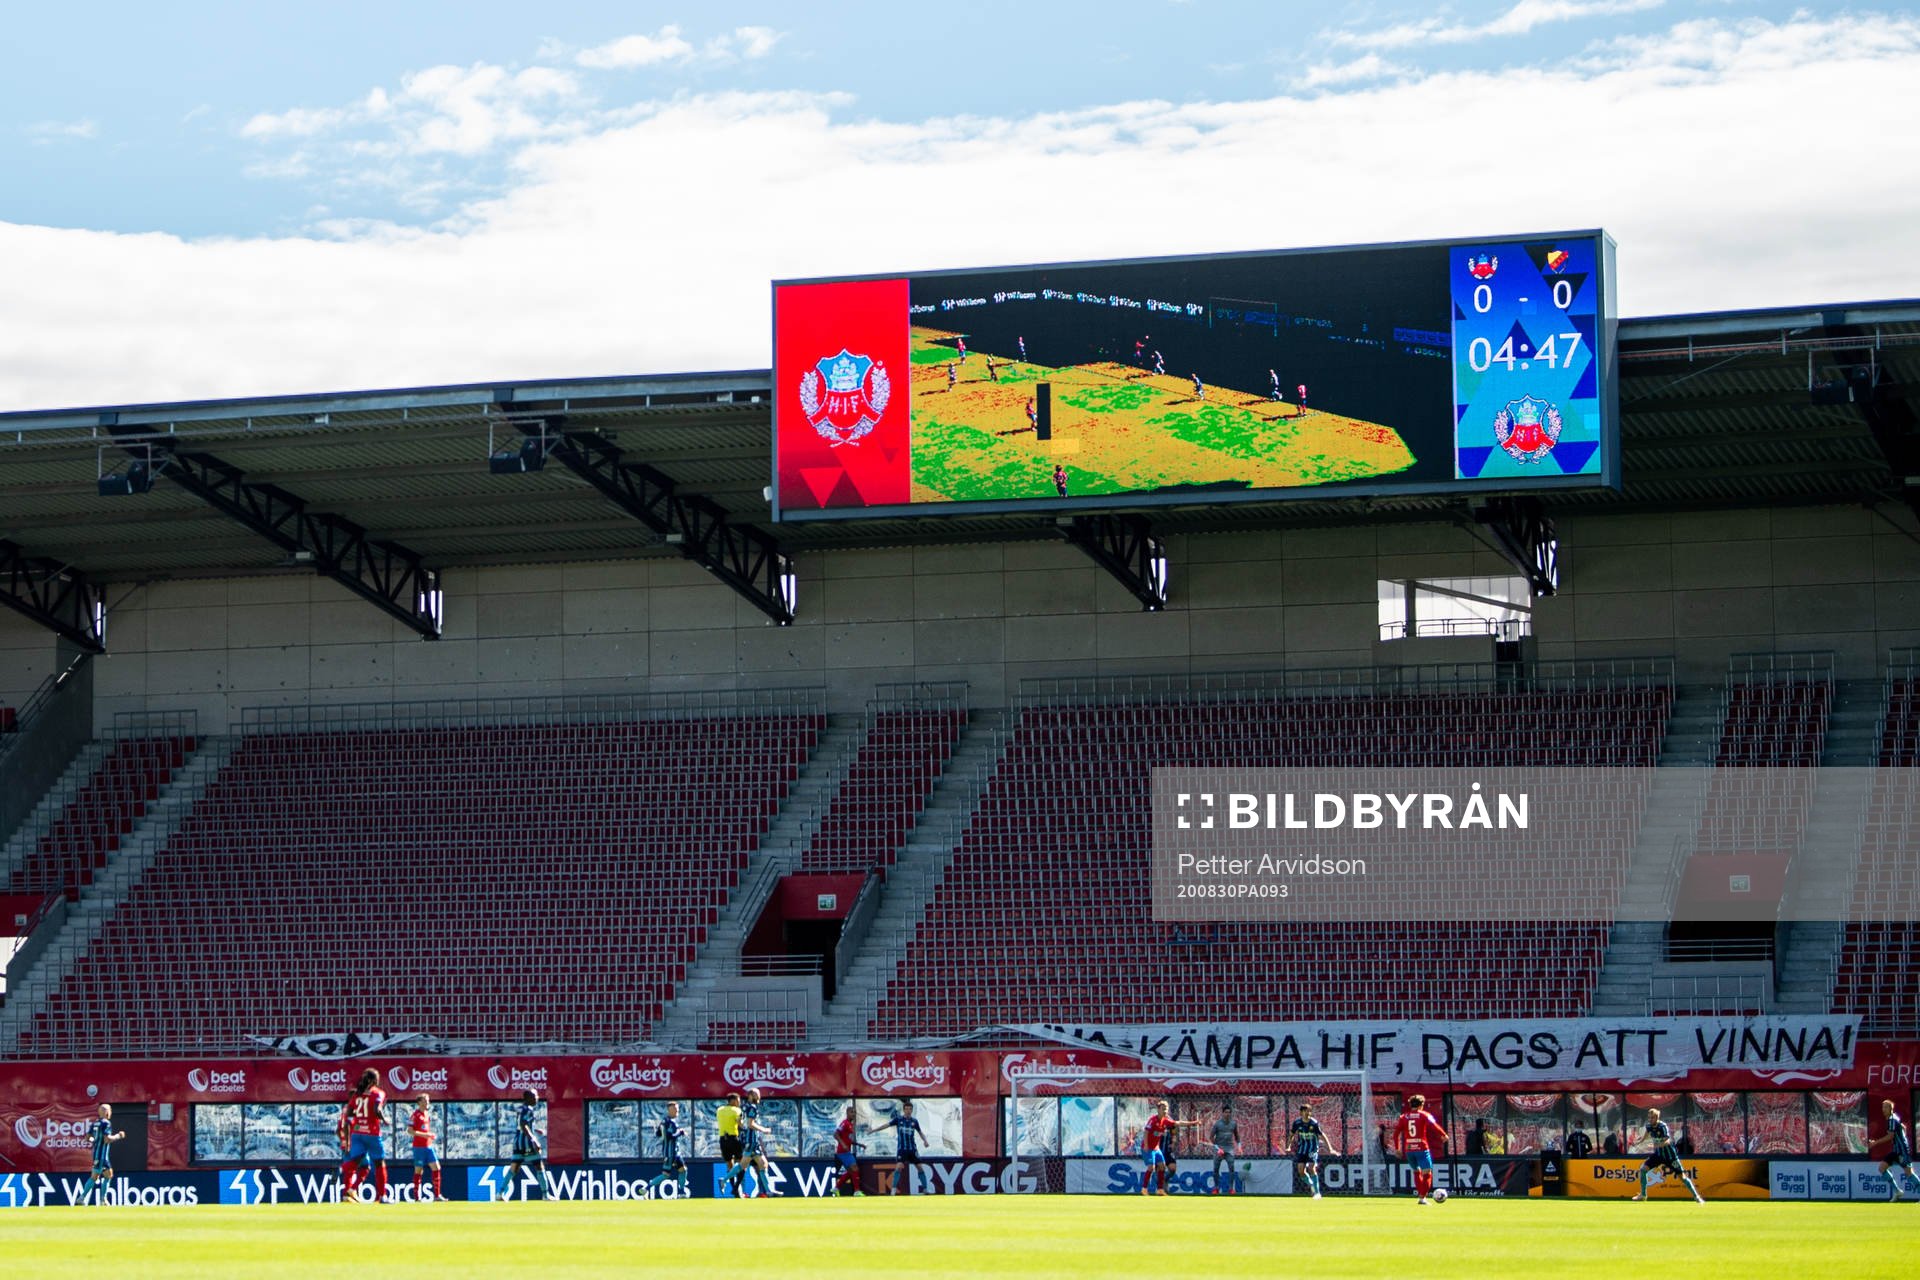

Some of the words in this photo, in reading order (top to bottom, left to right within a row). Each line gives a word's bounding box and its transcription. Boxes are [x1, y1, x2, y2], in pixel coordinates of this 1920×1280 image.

[1473, 284, 1493, 313] 0
[1553, 280, 1572, 309] 0
[1468, 332, 1583, 373] 04:47
[1140, 1029, 1305, 1069] KÄMPA
[1321, 1031, 1404, 1075] HIF,
[1422, 1031, 1558, 1071] DAGS
[1574, 1029, 1667, 1068] ATT
[1695, 1025, 1852, 1065] VINNA!
[210, 1069, 245, 1083] beat
[311, 1069, 346, 1082] beat
[412, 1068, 448, 1082] beat
[511, 1067, 548, 1080] beat
[590, 1058, 672, 1093] Carlsberg
[723, 1056, 806, 1091] Carlsberg
[861, 1055, 945, 1091] Carlsberg
[210, 1083, 245, 1093] diabetes
[311, 1082, 346, 1092] diabetes
[412, 1082, 448, 1091] diabetes
[511, 1080, 548, 1090] diabetes
[355, 1097, 369, 1118] 21
[46, 1118, 91, 1137] beat
[1408, 1119, 1417, 1138] 5
[908, 1161, 1037, 1194] BYGG
[1776, 1172, 1805, 1182] Paras
[1817, 1172, 1846, 1182] Paras
[1781, 1182, 1805, 1194] Bygg
[1822, 1182, 1846, 1194] Bygg
[1863, 1182, 1887, 1193] Bygg
